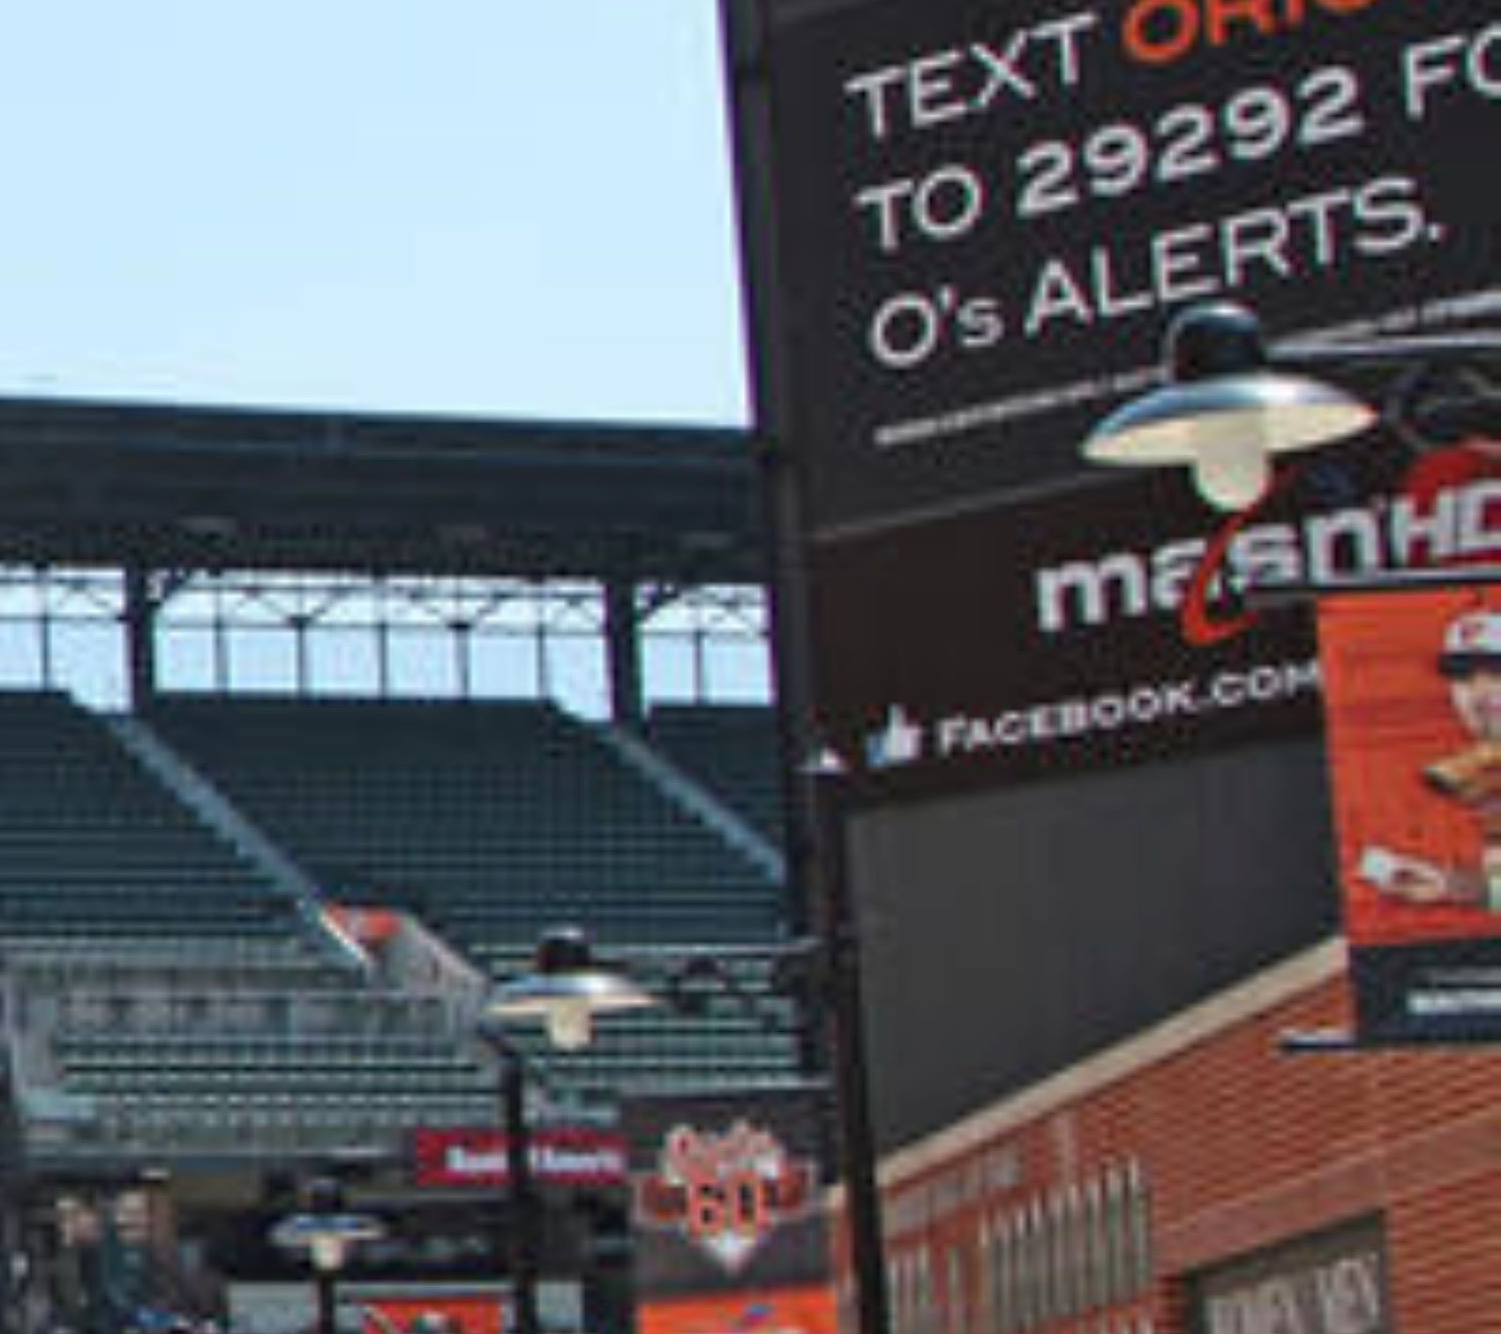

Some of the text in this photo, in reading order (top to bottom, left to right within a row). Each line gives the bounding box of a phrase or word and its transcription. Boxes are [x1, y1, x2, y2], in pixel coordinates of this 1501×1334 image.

[843, 12, 1099, 139] TEXT
[855, 164, 984, 252] TO
[1015, 65, 1365, 217] 29292
[870, 285, 1004, 369] O's
[1022, 177, 1447, 337] ALERTS.
